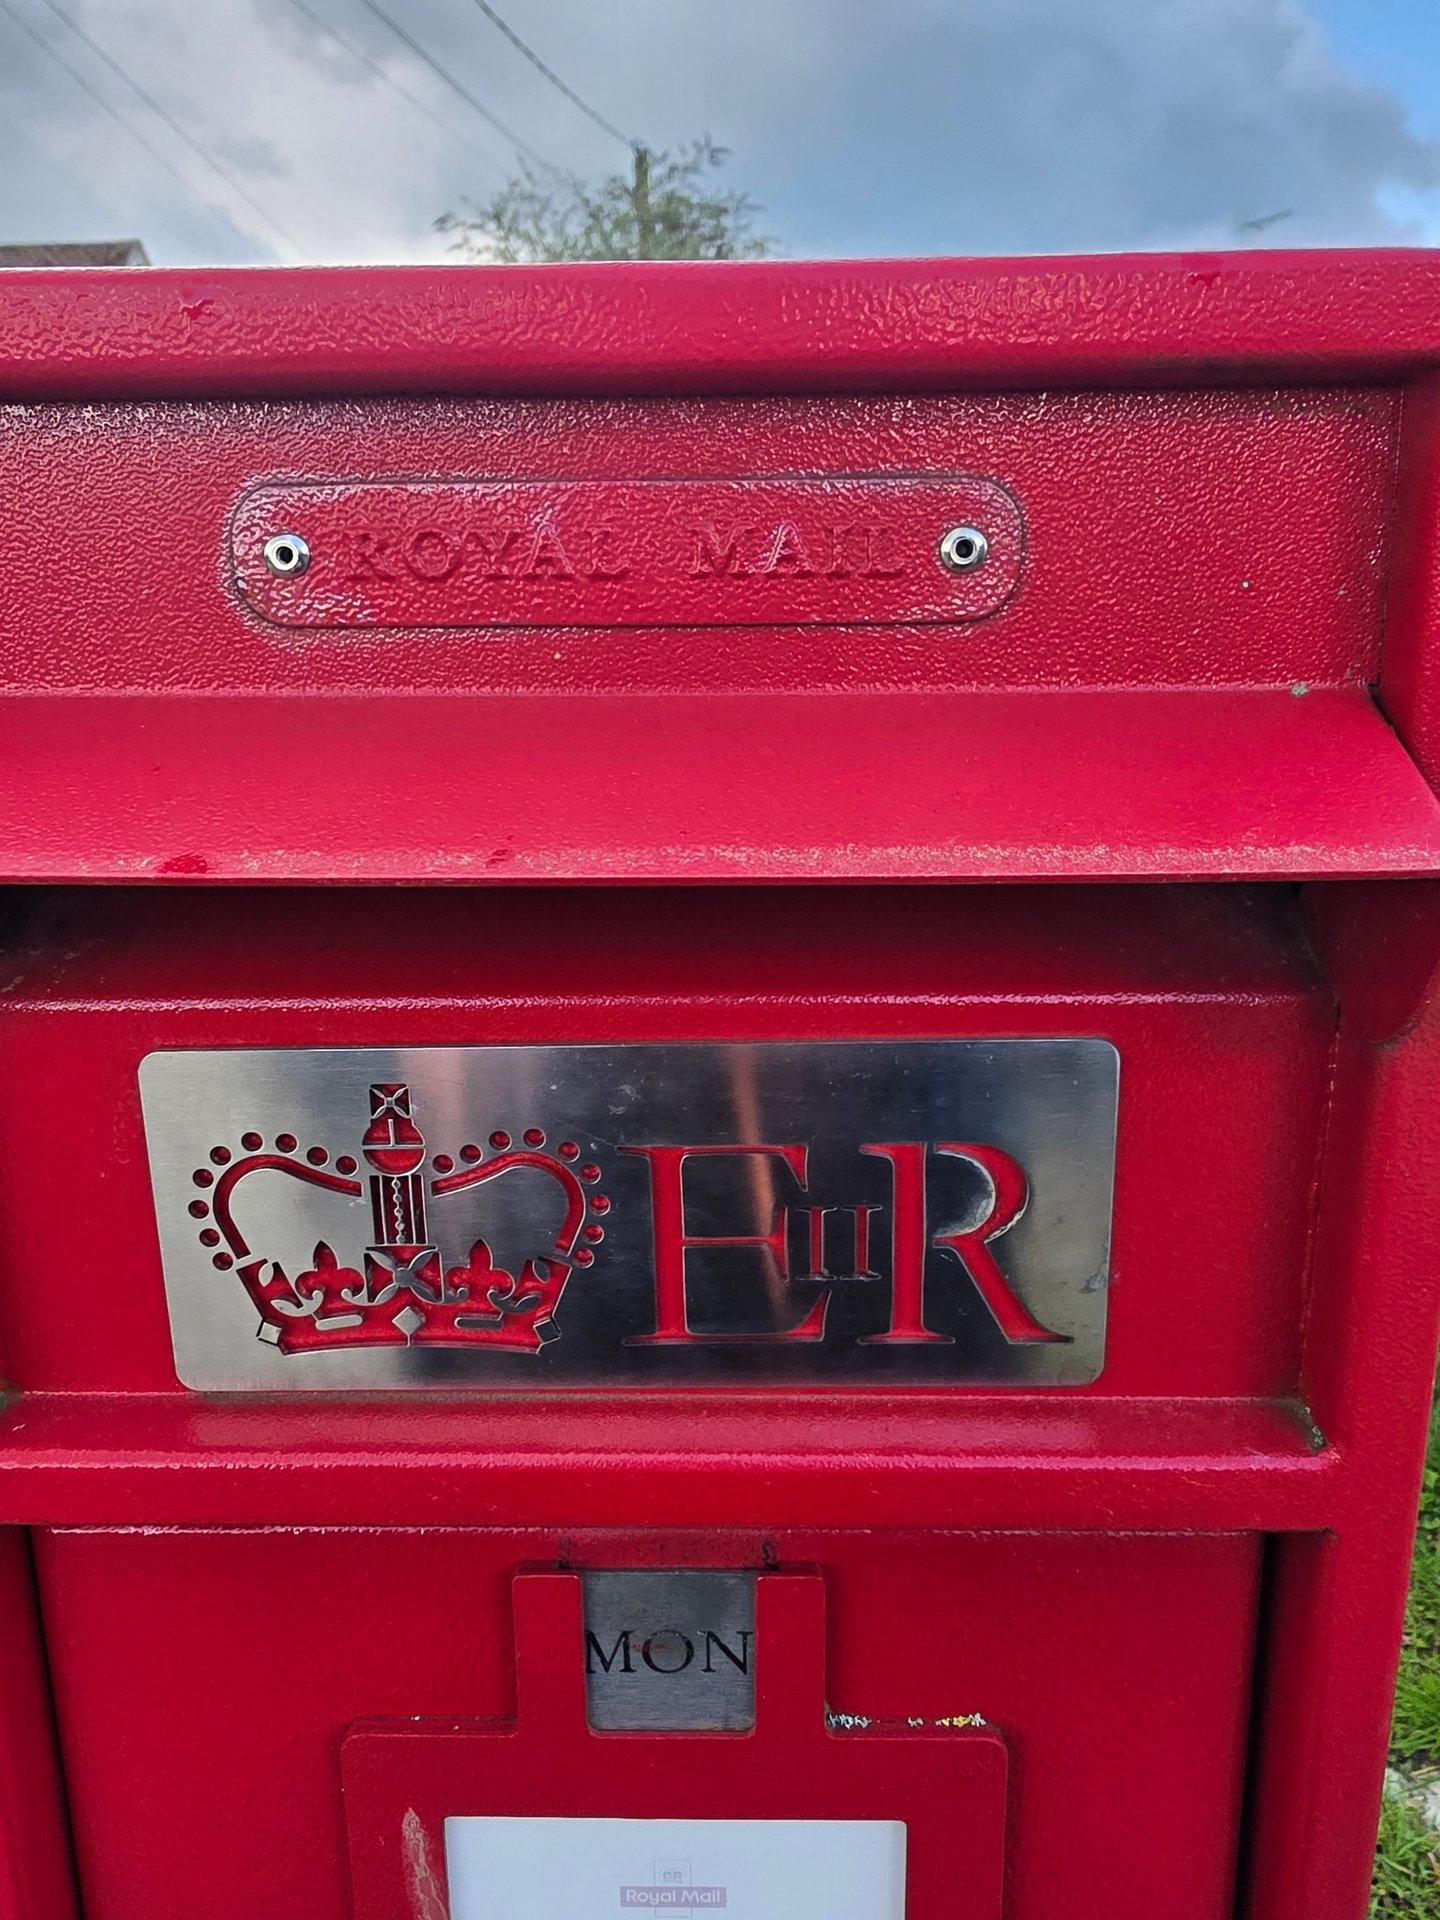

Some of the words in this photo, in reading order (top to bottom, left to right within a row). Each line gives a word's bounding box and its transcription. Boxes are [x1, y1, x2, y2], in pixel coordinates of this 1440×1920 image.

[343, 525, 630, 581] ROYAL
[687, 523, 907, 580] MAIL
[585, 1629, 754, 1675] MON
[625, 1889, 676, 1905] Royal
[681, 1889, 721, 1904] Mail
